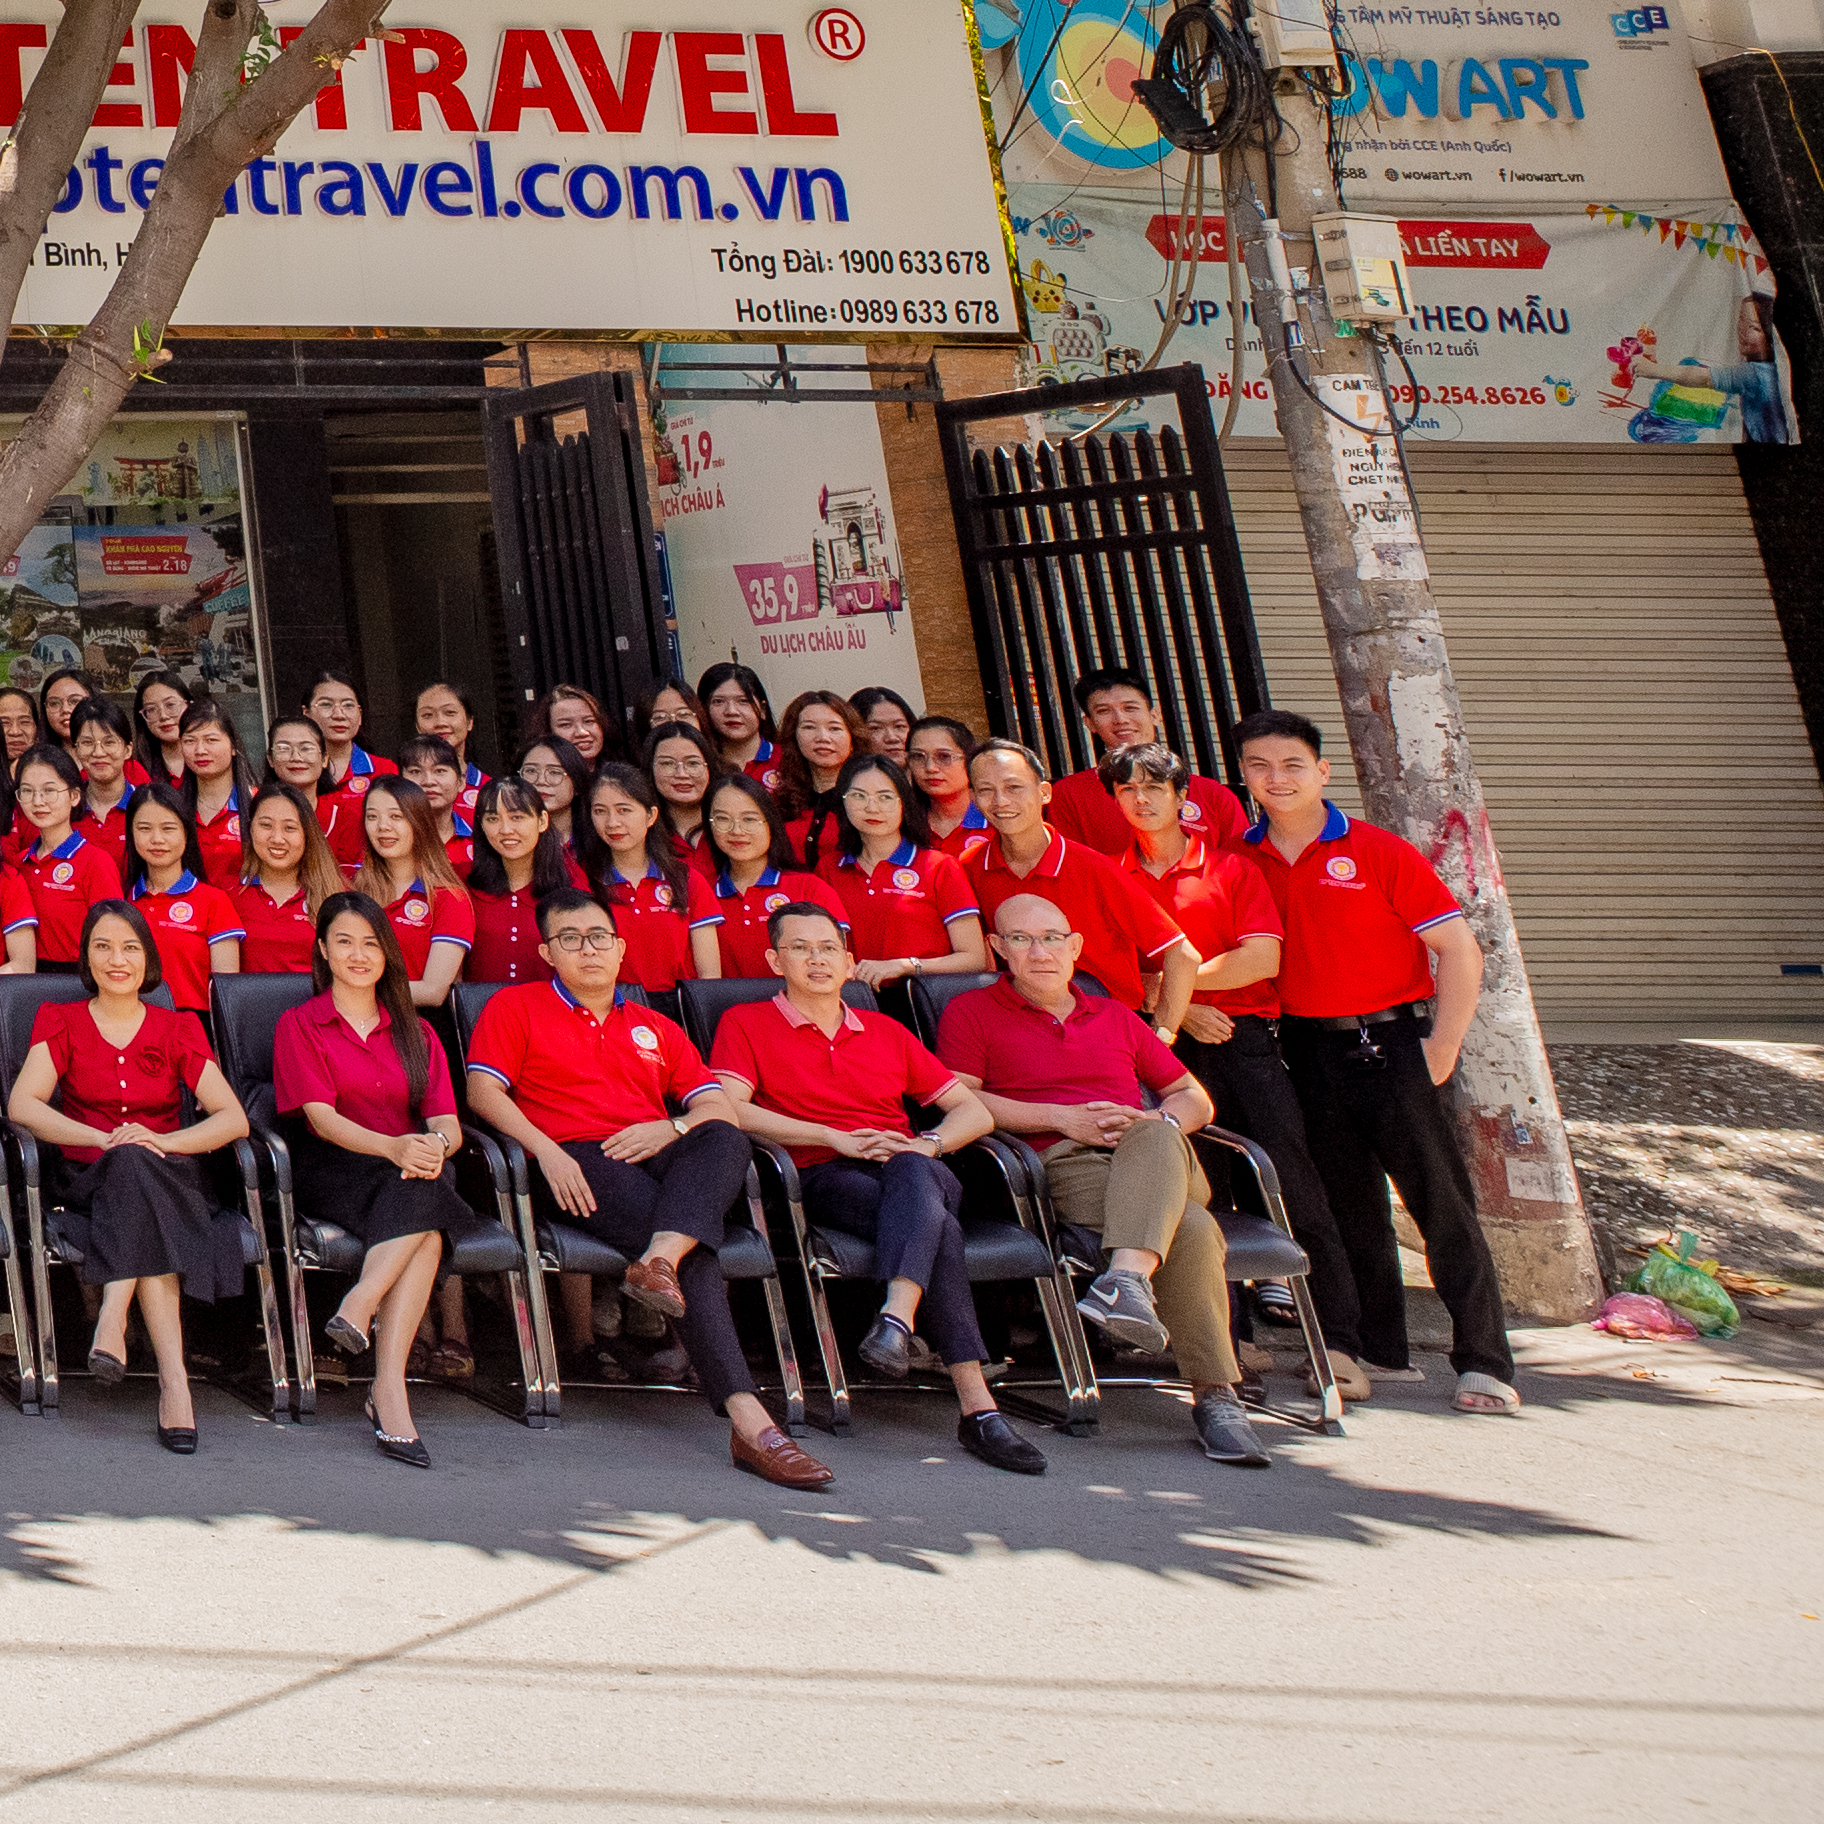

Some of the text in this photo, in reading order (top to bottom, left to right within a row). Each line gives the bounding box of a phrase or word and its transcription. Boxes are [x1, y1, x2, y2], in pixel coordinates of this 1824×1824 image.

[1458, 57, 1590, 119] ART
[710, 241, 777, 279] Tổng
[839, 249, 894, 275] 1900
[899, 250, 943, 275] 633
[945, 250, 990, 275] 678
[1472, 237, 1520, 258] TAY
[839, 299, 898, 324] 0989
[903, 300, 948, 324] 633
[955, 300, 1000, 324] 678
[1498, 295, 1572, 335] MẪU
[681, 430, 713, 479] 1,9
[749, 573, 800, 623] 35,9
[760, 633, 778, 654] DU
[808, 625, 844, 652] CHÂU
